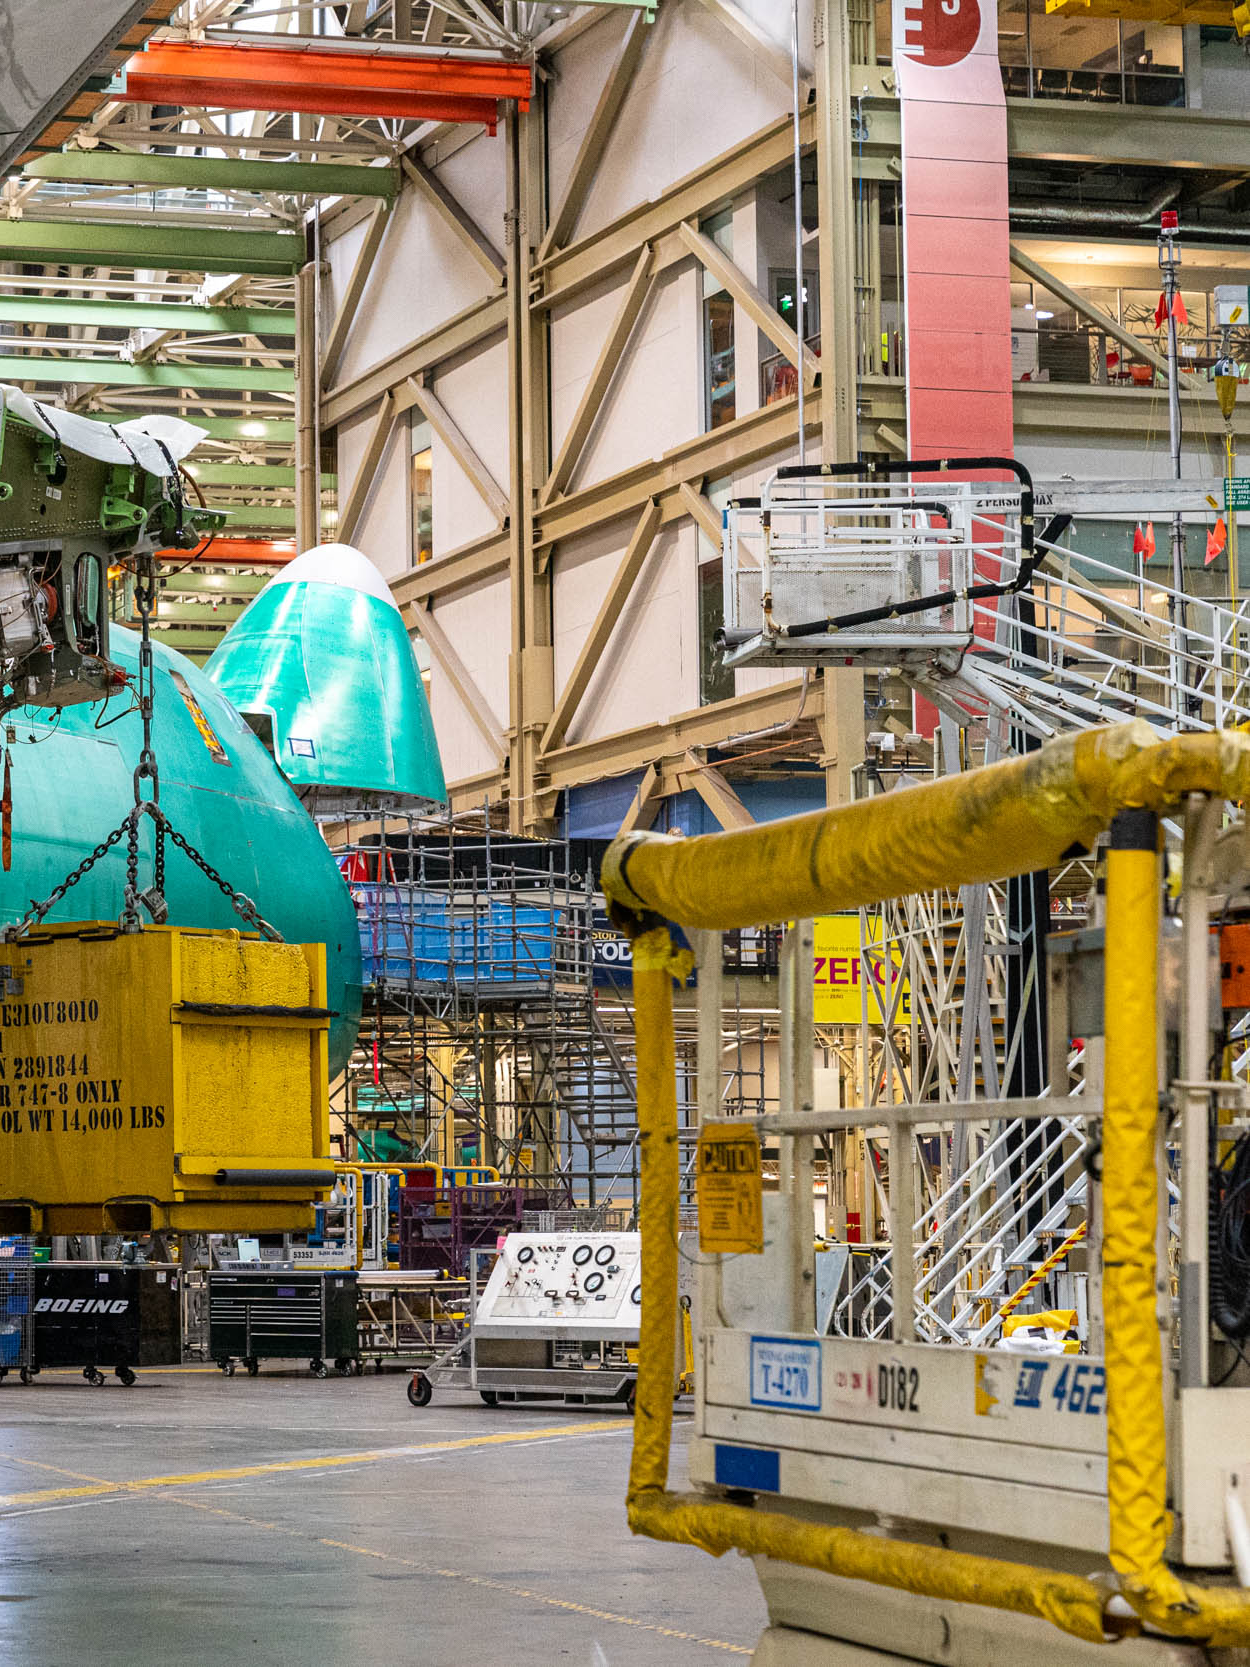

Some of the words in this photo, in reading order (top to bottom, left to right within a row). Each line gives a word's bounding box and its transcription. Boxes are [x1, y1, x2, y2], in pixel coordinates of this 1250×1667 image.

[13, 1054, 89, 1080] 2891844
[18, 1082, 69, 1107] 747-8
[76, 1079, 122, 1104] ONLY
[28, 1110, 55, 1132] WT
[62, 1107, 123, 1136] 14,000
[130, 1105, 165, 1130] LBS
[34, 1298, 129, 1314] BOEING
[878, 1363, 919, 1412] D182
[1053, 1363, 1108, 1415] 462
